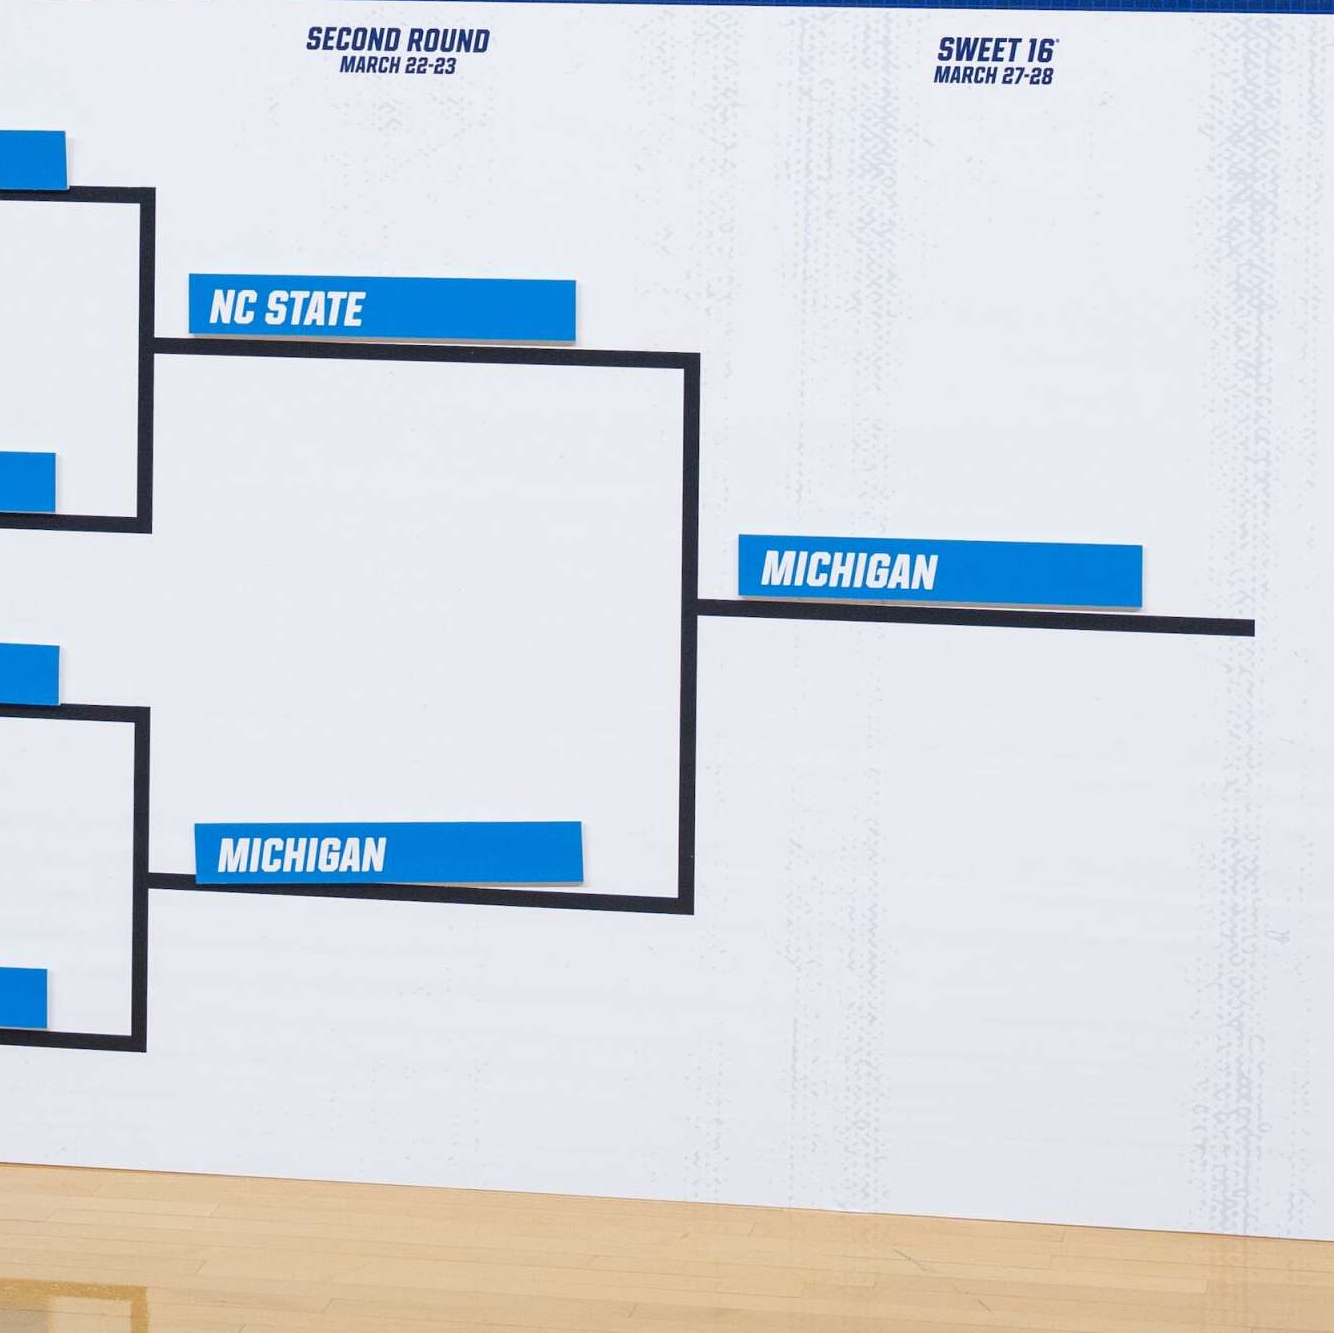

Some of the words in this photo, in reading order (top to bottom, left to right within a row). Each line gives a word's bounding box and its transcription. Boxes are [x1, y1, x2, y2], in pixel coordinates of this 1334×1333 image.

[306, 26, 401, 52] SECOND
[406, 28, 491, 54] ROUND
[937, 36, 1023, 62] SWEET
[1027, 38, 1055, 63] 16
[339, 55, 402, 74] MARCH
[404, 56, 457, 75] 22-23
[933, 65, 998, 84] MARCH
[1001, 66, 1054, 85] 27-28
[209, 289, 259, 324] NC
[265, 290, 366, 327] STATE
[761, 550, 938, 590] MICHIGAN
[217, 837, 387, 874] MICHIGAN
